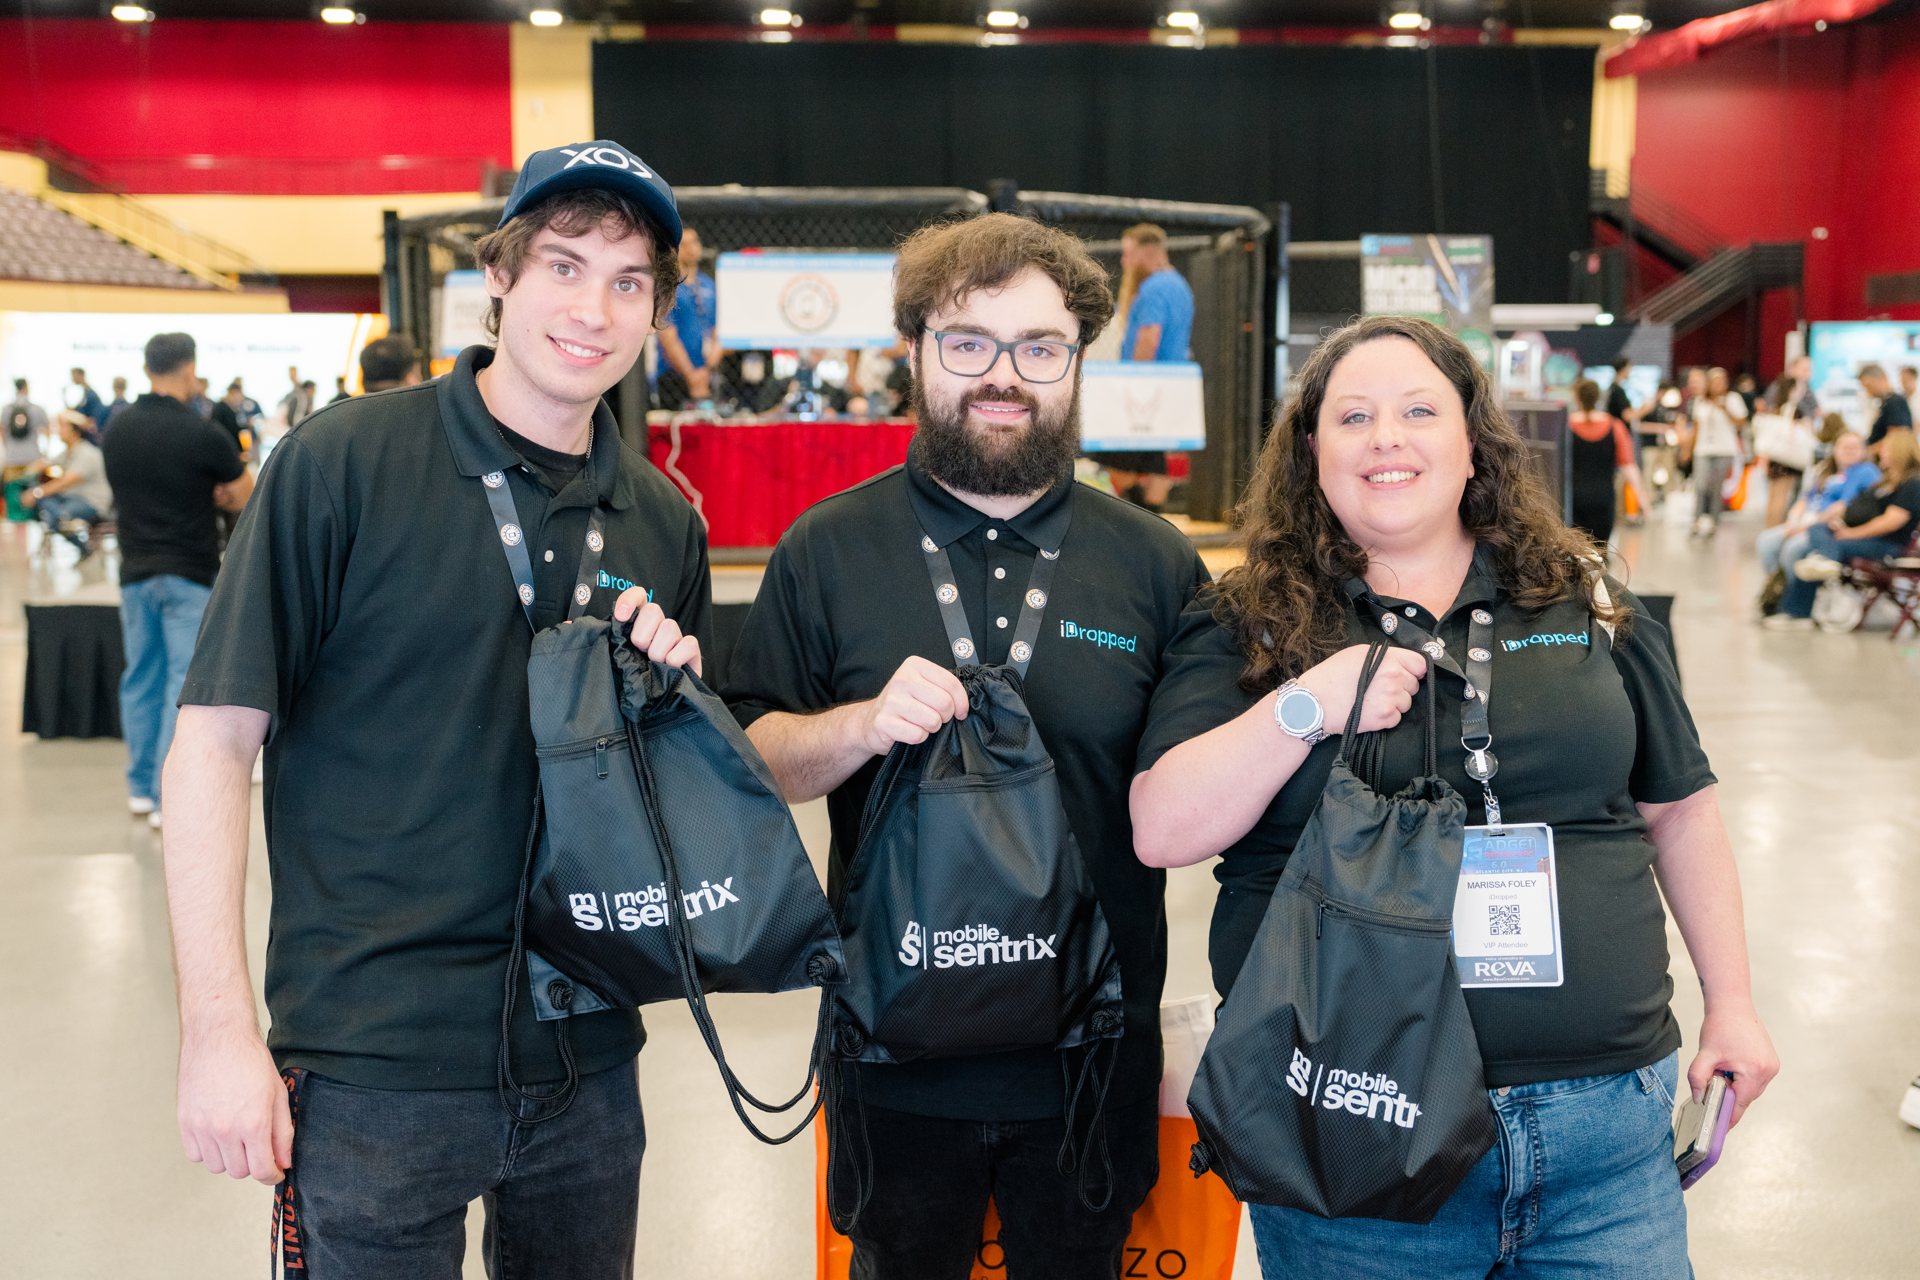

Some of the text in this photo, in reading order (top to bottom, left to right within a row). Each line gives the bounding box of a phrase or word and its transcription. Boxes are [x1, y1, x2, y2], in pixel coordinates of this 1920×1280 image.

[1060, 619, 1137, 653] iDropped
[1501, 630, 1590, 652] iDropped
[614, 882, 667, 910] mobi
[1467, 880, 1537, 889] MARISSA FOLEY
[617, 877, 740, 931] setrix
[933, 924, 1000, 946] mobile
[933, 933, 1057, 969] sentrix
[1326, 1069, 1398, 1095] mobile
[1322, 1084, 1423, 1129] sentr
[284, 1186, 304, 1269] LINUS
